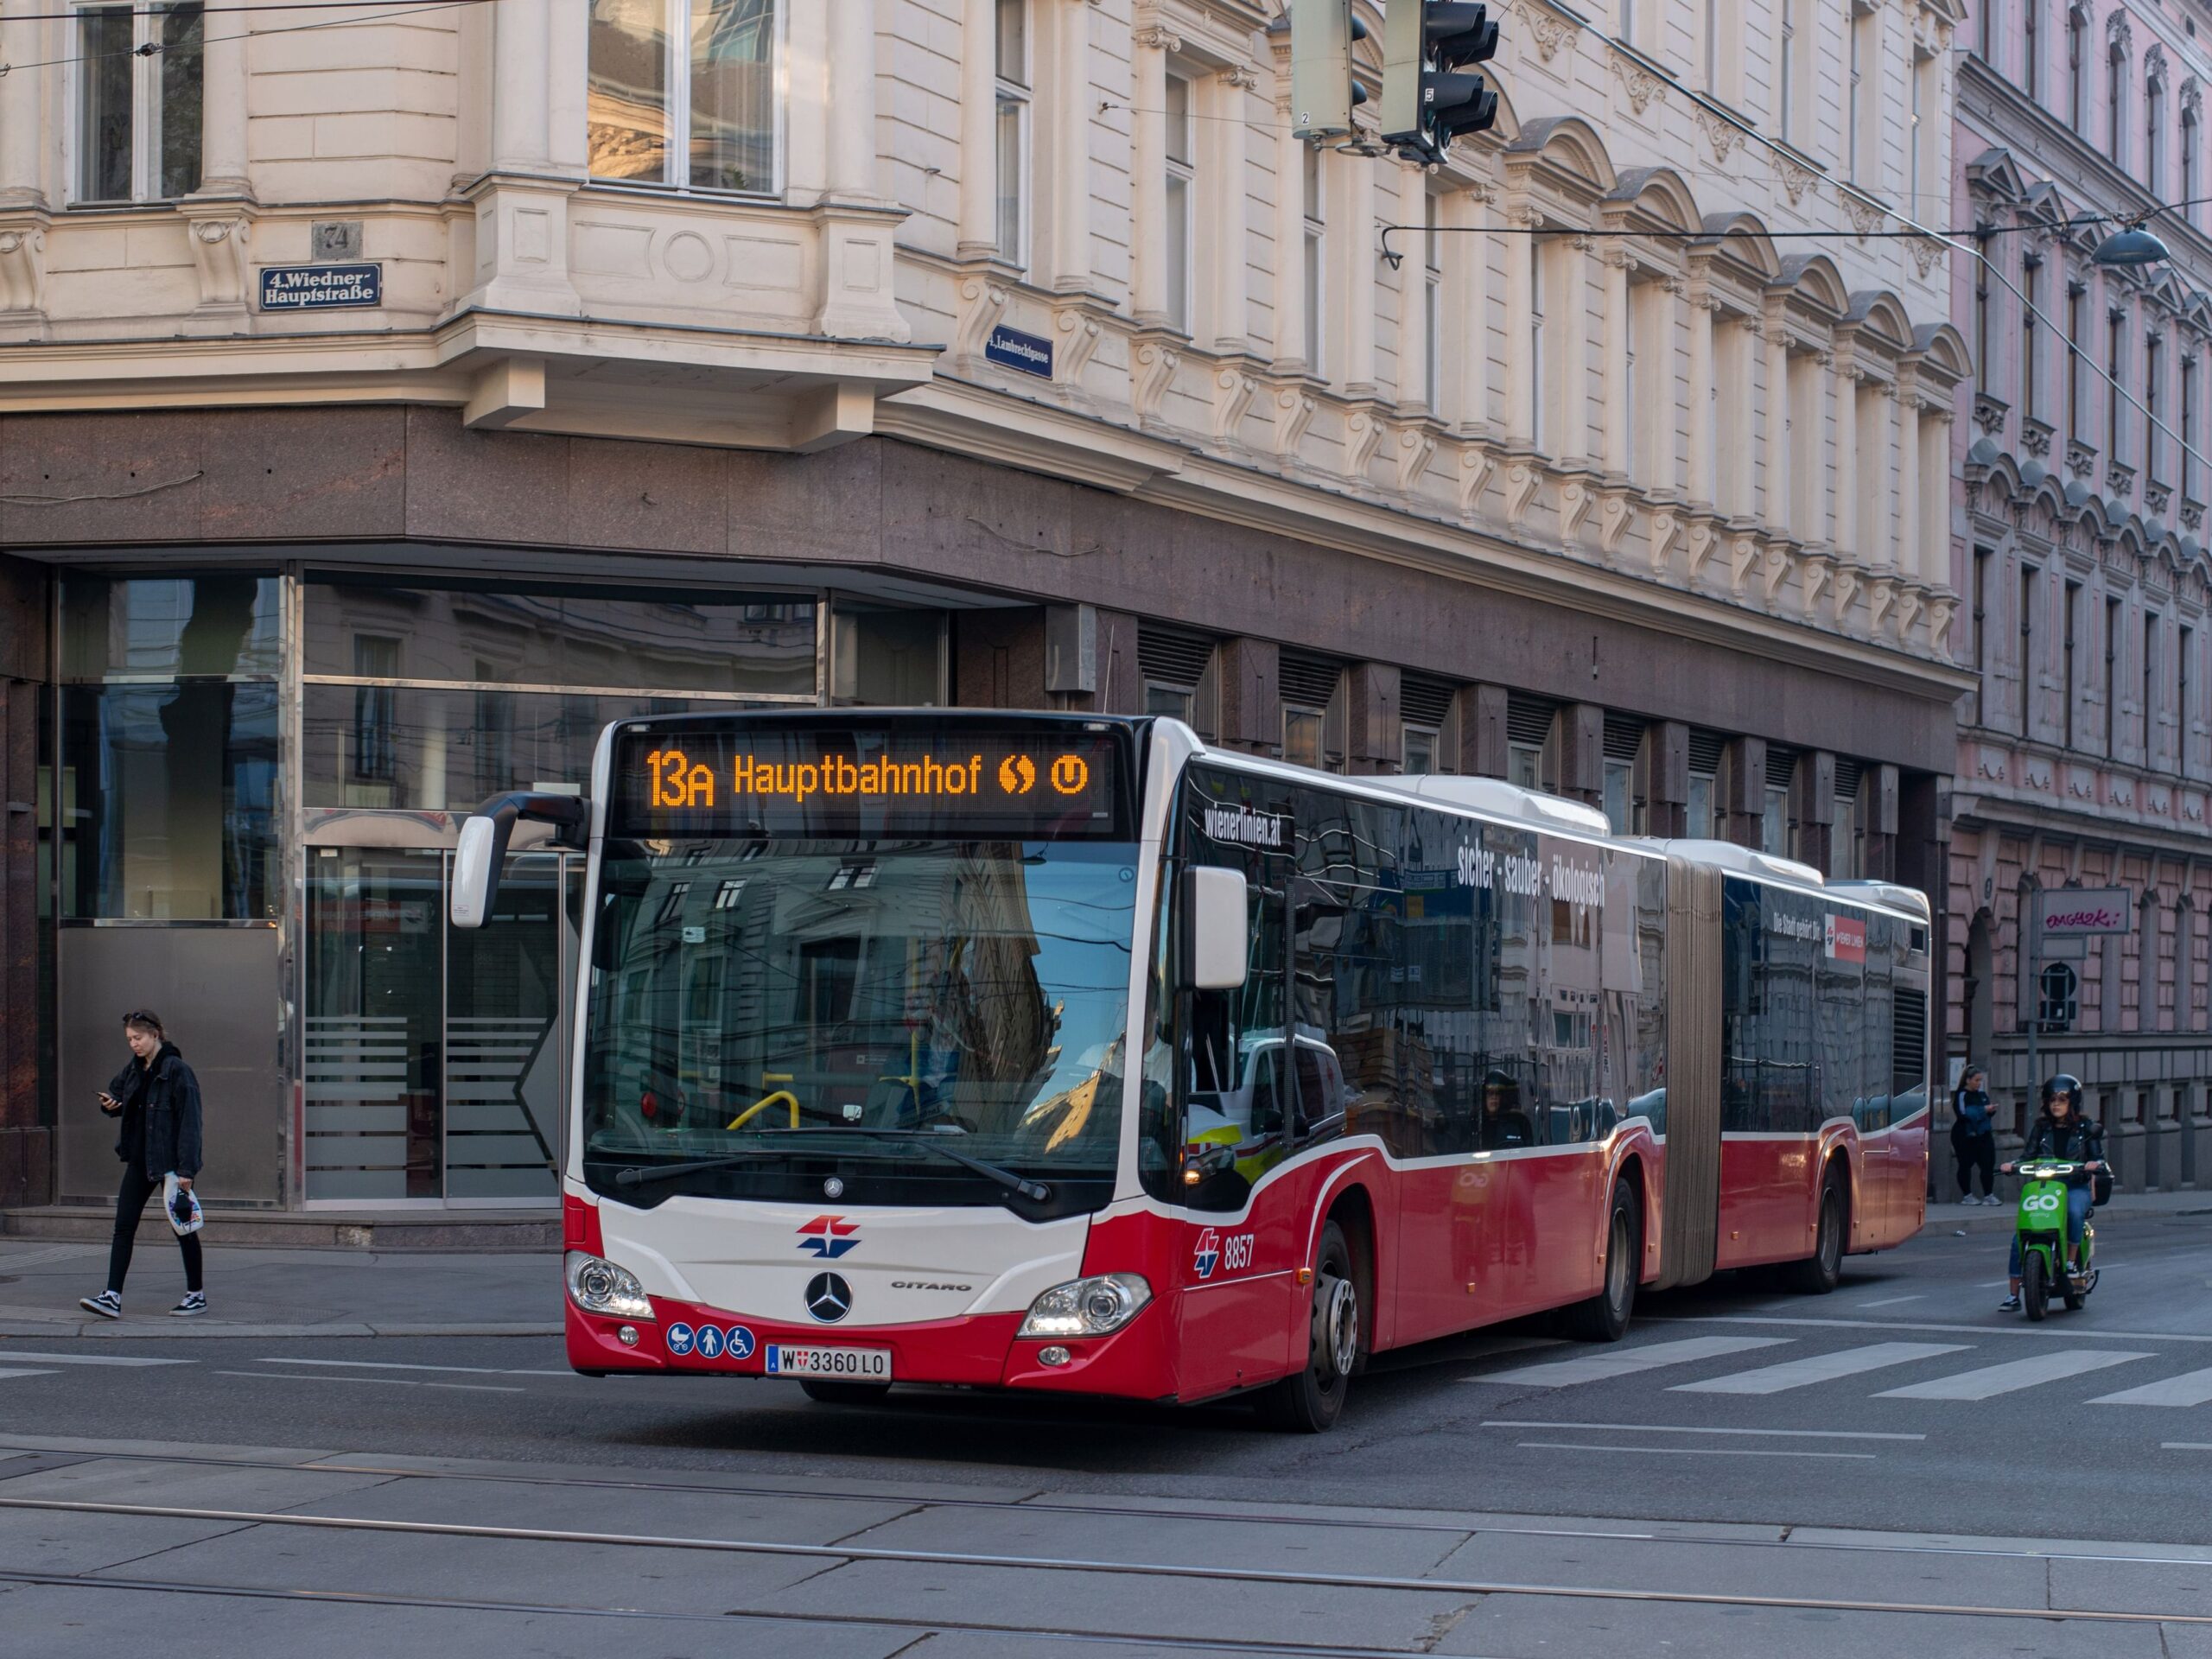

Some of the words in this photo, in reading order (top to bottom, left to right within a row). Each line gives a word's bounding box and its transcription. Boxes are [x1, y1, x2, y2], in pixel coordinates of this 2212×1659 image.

[1426, 89, 1433, 101] 5
[1302, 112, 1309, 124] 2
[324, 225, 349, 249] 74
[264, 285, 375, 306] Hauptstraße
[646, 750, 715, 806] 13A
[734, 754, 982, 802] Hauptbahnhof
[1205, 801, 1281, 847] wienerlinien.at
[1458, 835, 1495, 889] sicher
[1504, 847, 1542, 897] sauber
[1553, 855, 1605, 916] ökologisch
[2022, 1194, 2059, 1211] GO
[1224, 1233, 1255, 1270] 8857
[891, 1281, 972, 1292] CITARO
[782, 1350, 795, 1370] W
